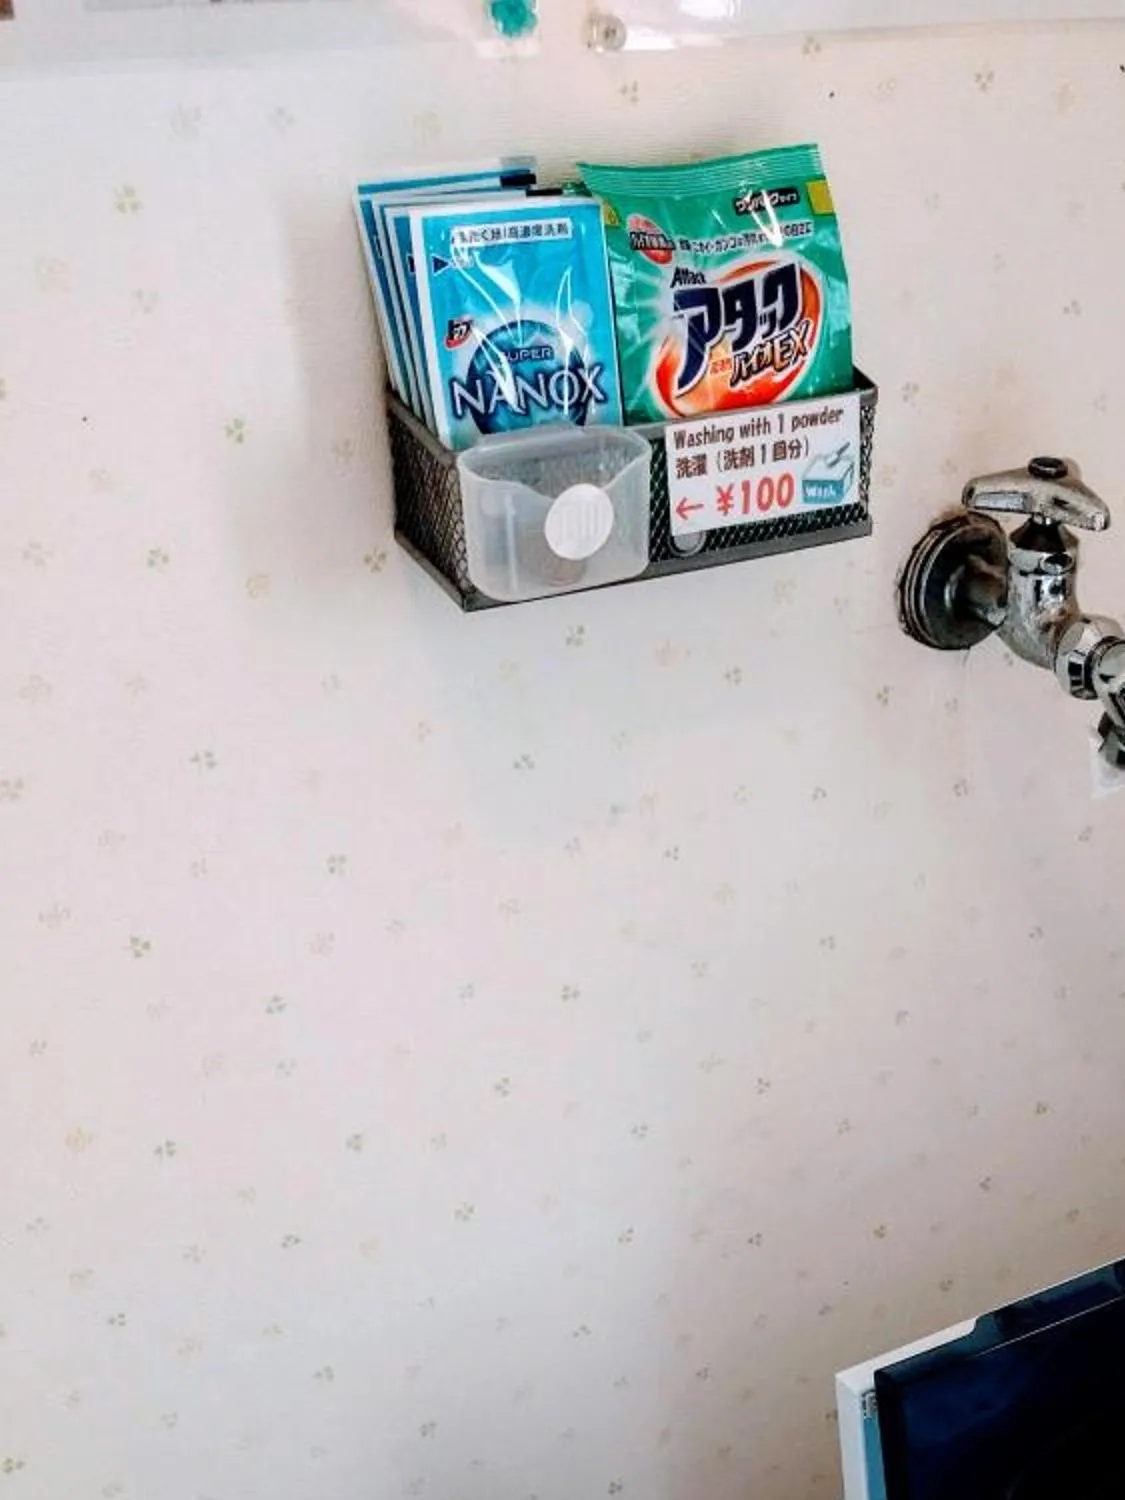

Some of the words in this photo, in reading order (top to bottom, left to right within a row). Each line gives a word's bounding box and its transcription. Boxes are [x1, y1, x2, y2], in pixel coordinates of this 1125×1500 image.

[673, 263, 799, 390] アタック
[502, 347, 551, 362] SUPER
[452, 365, 606, 417] NANOX
[674, 426, 735, 449] Washing
[739, 415, 771, 438] with
[778, 413, 784, 434] 1
[791, 406, 844, 432] powder
[716, 472, 795, 516] ¥100
